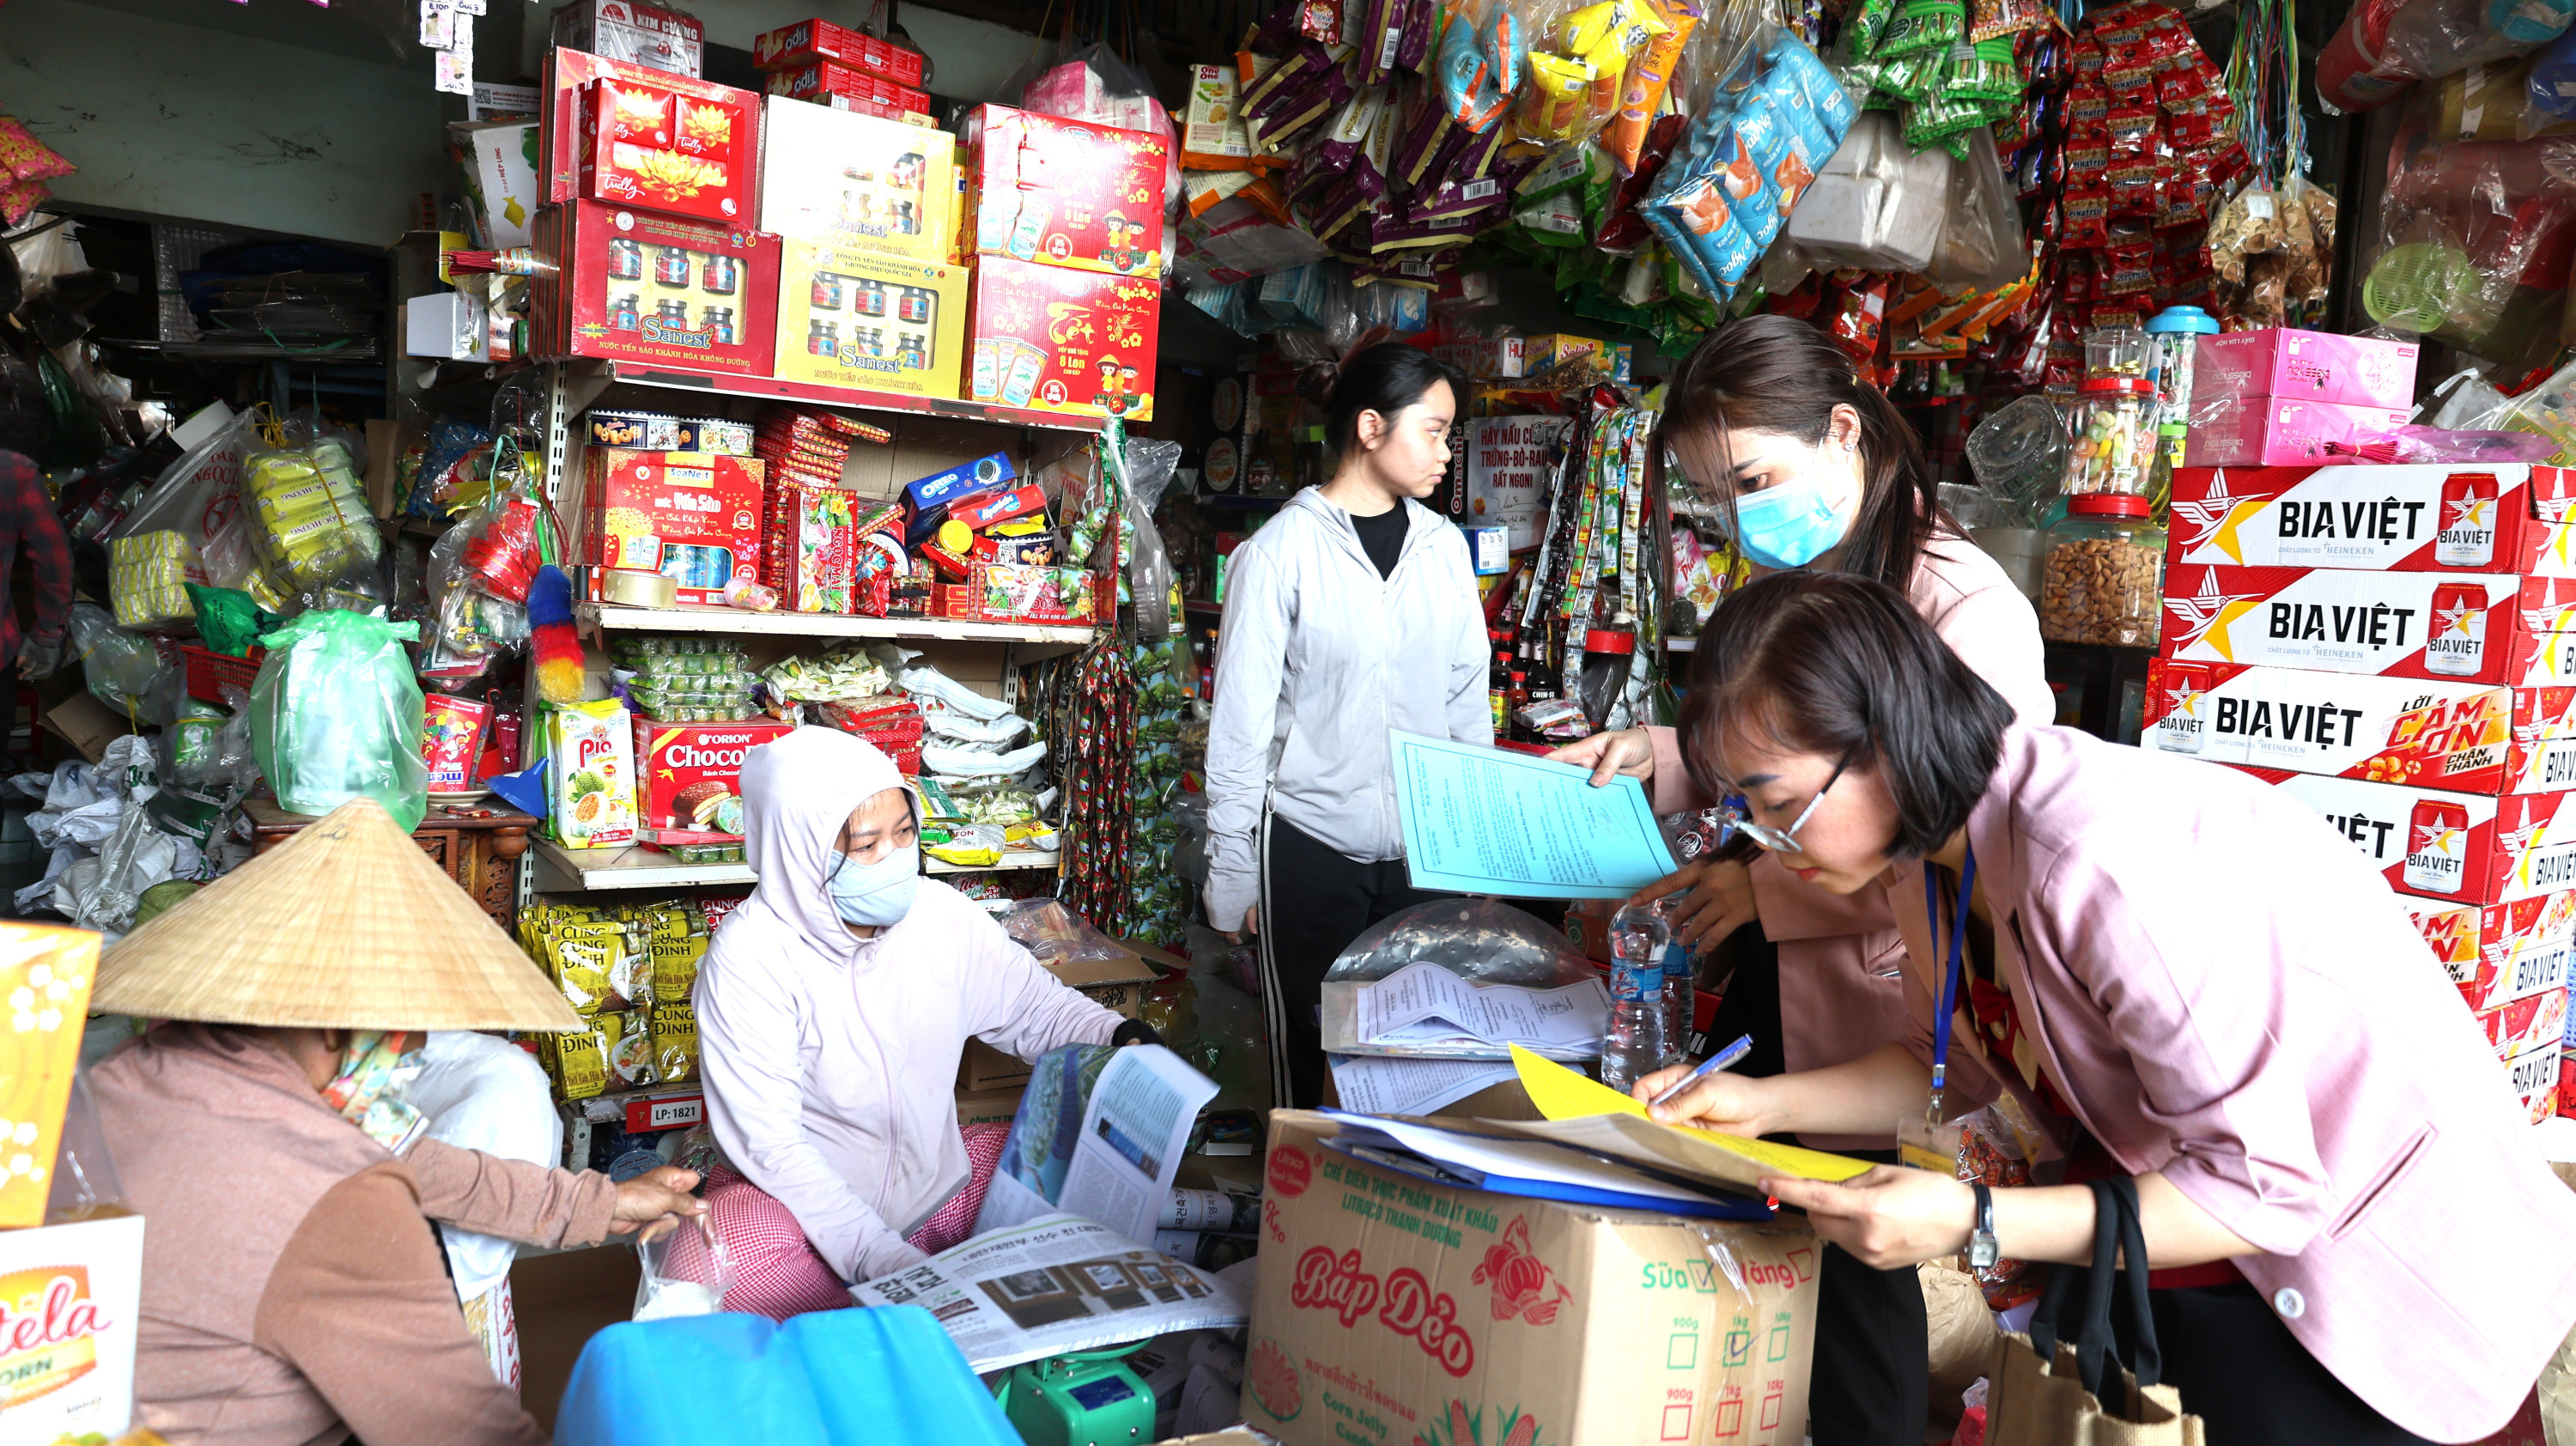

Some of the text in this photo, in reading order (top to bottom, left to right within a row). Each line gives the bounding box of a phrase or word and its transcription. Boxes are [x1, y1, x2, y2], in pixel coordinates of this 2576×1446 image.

[636, 15, 659, 31] KIM
[2072, 159, 2107, 169] PINATTSU
[2068, 208, 2102, 217] PINATTSU
[835, 252, 854, 261] CÔNG
[863, 255, 874, 265] YẾN
[875, 258, 887, 267] SÀO
[887, 259, 907, 270] KHÁNH
[908, 263, 920, 272] HÒA
[845, 261, 868, 271] THƯƠNG
[870, 264, 884, 274] HIỆU
[902, 269, 912, 277] GIA
[643, 318, 710, 348] Sanest
[1047, 302, 1097, 344] Tết
[2215, 336, 2256, 348] GIẤY LỤA HỘP
[598, 341, 750, 367] NƯỚC YẾN SÀO KHÁNH HÒA KHÔNG ĐƯỜNG
[841, 345, 901, 374] Sanest
[1060, 355, 1085, 369] 8 Lon
[858, 374, 873, 385] SÀO
[875, 375, 905, 387] KHÁNH
[906, 380, 923, 391] HÒA
[1480, 423, 1521, 446] HÃY NẤU
[1451, 436, 1463, 513] Omachi
[1492, 471, 1533, 488] RẤT NGON!
[280, 486, 313, 501] HƯƠNG
[921, 474, 958, 498] OREO
[289, 519, 322, 536] HƯƠNG
[2278, 495, 2426, 545] BIA VIỆT
[2439, 528, 2493, 549] BIA VIỆT
[831, 527, 843, 592] NGỌC MAI
[2278, 544, 2292, 554] CHẤT
[2292, 546, 2312, 556] LƯỢNG
[2326, 545, 2374, 556] HEINEKEN
[2269, 601, 2416, 651] BIA VIỆT
[2268, 646, 2281, 654] CHẤT
[2281, 647, 2301, 657] LƯỢNG
[2316, 648, 2364, 659] HEINEKEN
[2429, 638, 2481, 657] BIA VIỆT
[1532, 690, 1555, 699] CHIN-SU
[2401, 694, 2435, 713] LỜI
[2159, 715, 2204, 735] BIA VIỆT
[2216, 696, 2363, 751] BIA VIỆT
[2385, 695, 2494, 749] CẢM
[711, 734, 750, 744] ORION
[2215, 738, 2227, 747] CHẤT
[2260, 744, 2306, 755] HEINEKEN
[2420, 720, 2494, 758] ƠN
[2444, 754, 2494, 774] THÀNH
[2446, 746, 2488, 763] CHÂN
[2545, 751, 2566, 783] BIA
[2408, 852, 2461, 875] BIA VIỆT
[2536, 857, 2555, 886] BIA
[653, 945, 690, 957] ĐÌNH
[2517, 949, 2565, 991] BIA VIỆT
[653, 1009, 694, 1022] CUNG
[654, 1023, 694, 1036] ĐÌNH
[2533, 1052, 2556, 1089] VIỆT
[655, 1106, 696, 1121] LP: 1821
[1276, 1149, 1304, 1170] Litraco
[1322, 1160, 1499, 1234] CHẾ BIẾN THỰC PHẨM XUẤT KHẨU
[1265, 1199, 1285, 1244] Kẹo
[1341, 1192, 1385, 1223] LITRACO
[1385, 1207, 1421, 1236] THANH
[1291, 1246, 1474, 1378] Bắp Dẻo
[1673, 1312, 1791, 1330] 900g 1kg 10kg
[1667, 1380, 1784, 1403] 900g 1kg 10kg
[1321, 1388, 1388, 1441] Corn Jelly
